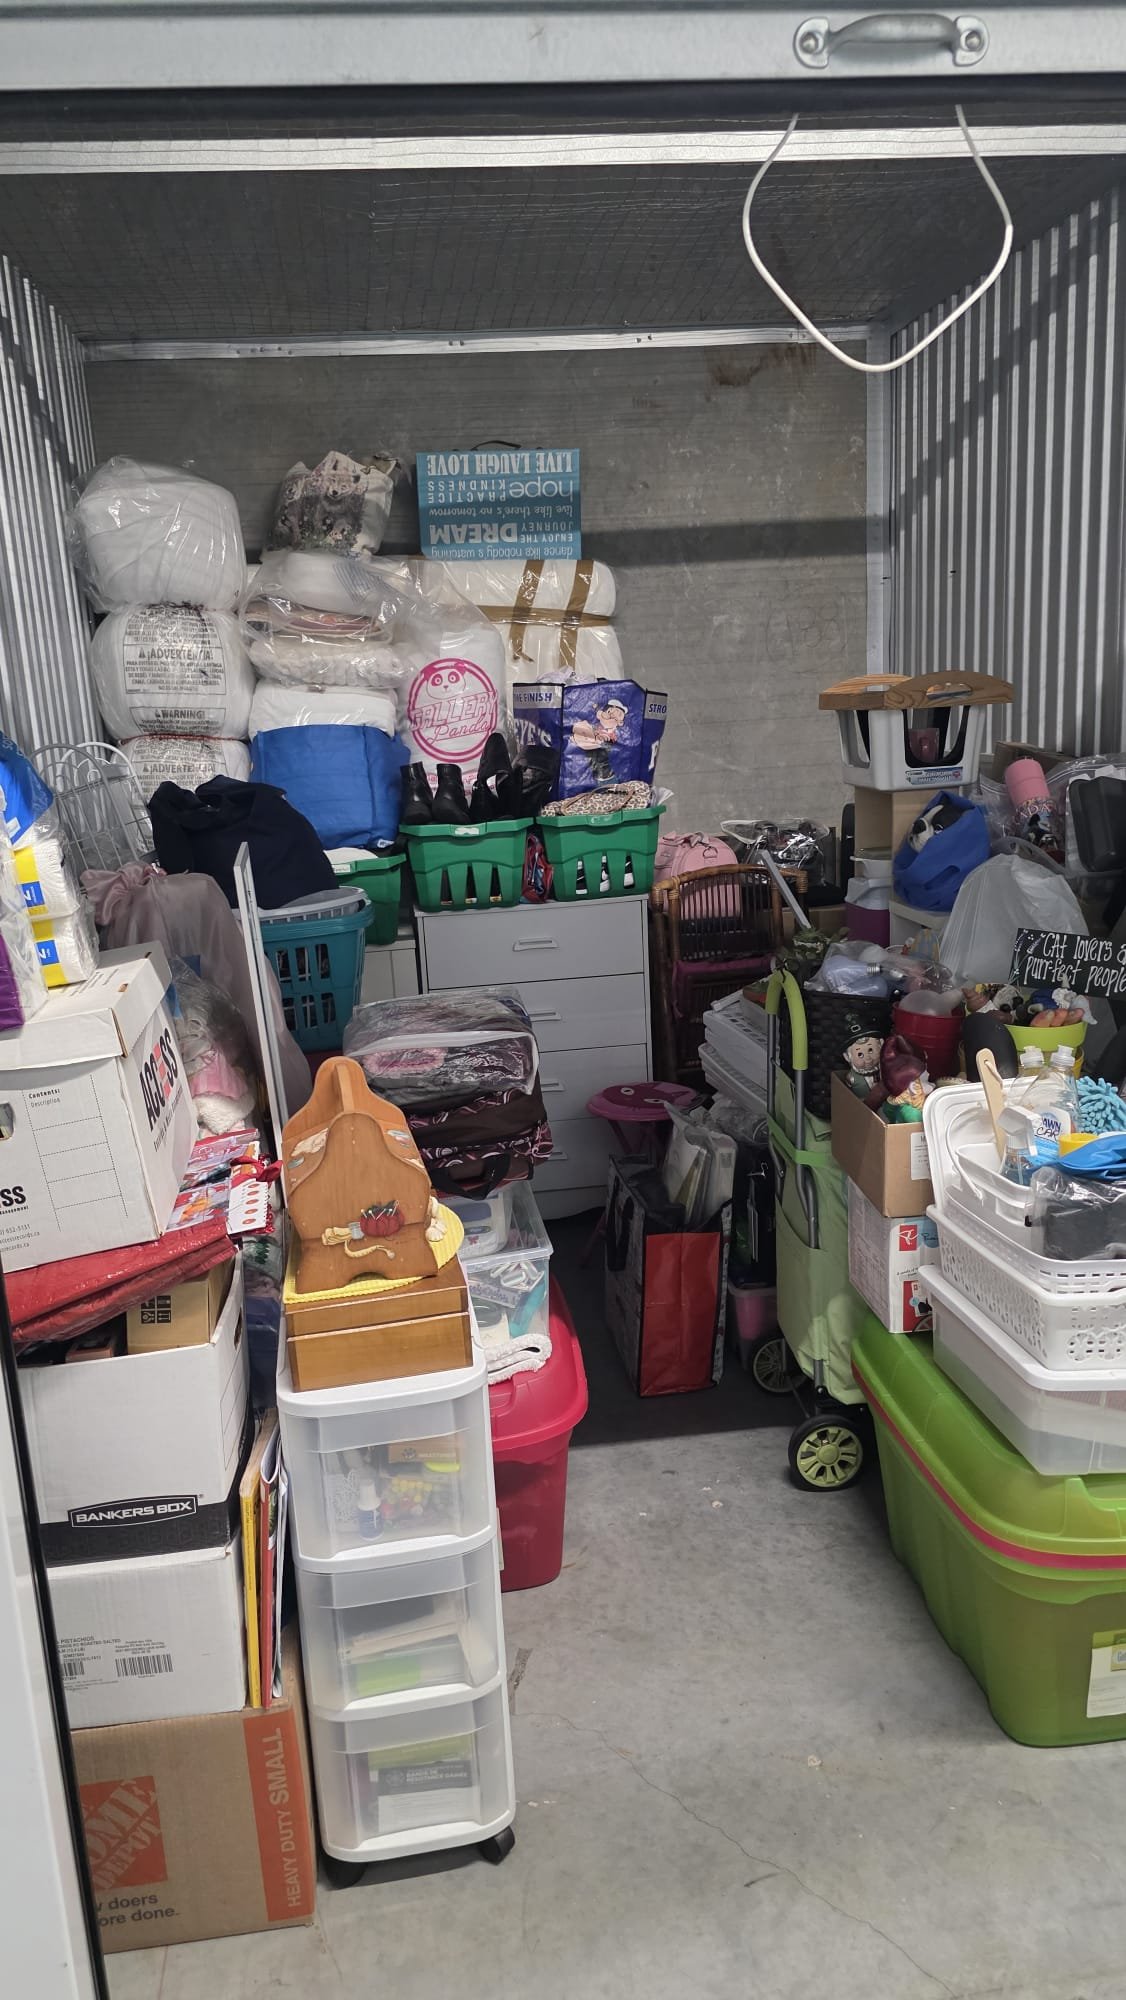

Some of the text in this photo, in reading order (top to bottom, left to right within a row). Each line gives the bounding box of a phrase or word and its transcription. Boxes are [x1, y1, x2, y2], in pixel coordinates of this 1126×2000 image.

[427, 452, 573, 476] LIVE LAUGH LOVE
[427, 479, 506, 492] KINDNESS
[509, 475, 573, 503] hope
[427, 492, 506, 504] PRACTICE
[429, 507, 477, 517] tomorrow
[534, 505, 553, 518] like
[429, 522, 518, 545] DREAM
[521, 521, 573, 532] JOURNEY
[520, 534, 573, 544] ENJOY THE
[525, 546, 541, 560] like
[544, 546, 573, 560] dance
[1073, 936, 1113, 962] lovers
[28, 1088, 61, 1099] Contents:
[1042, 1117, 1061, 1133] AWN
[76, 1501, 193, 1523] BANKERS BOX
[262, 1727, 301, 1908] HEAVY DUTY SMALL
[108, 1893, 158, 1911] doers
[99, 1906, 181, 1928] ore done.
